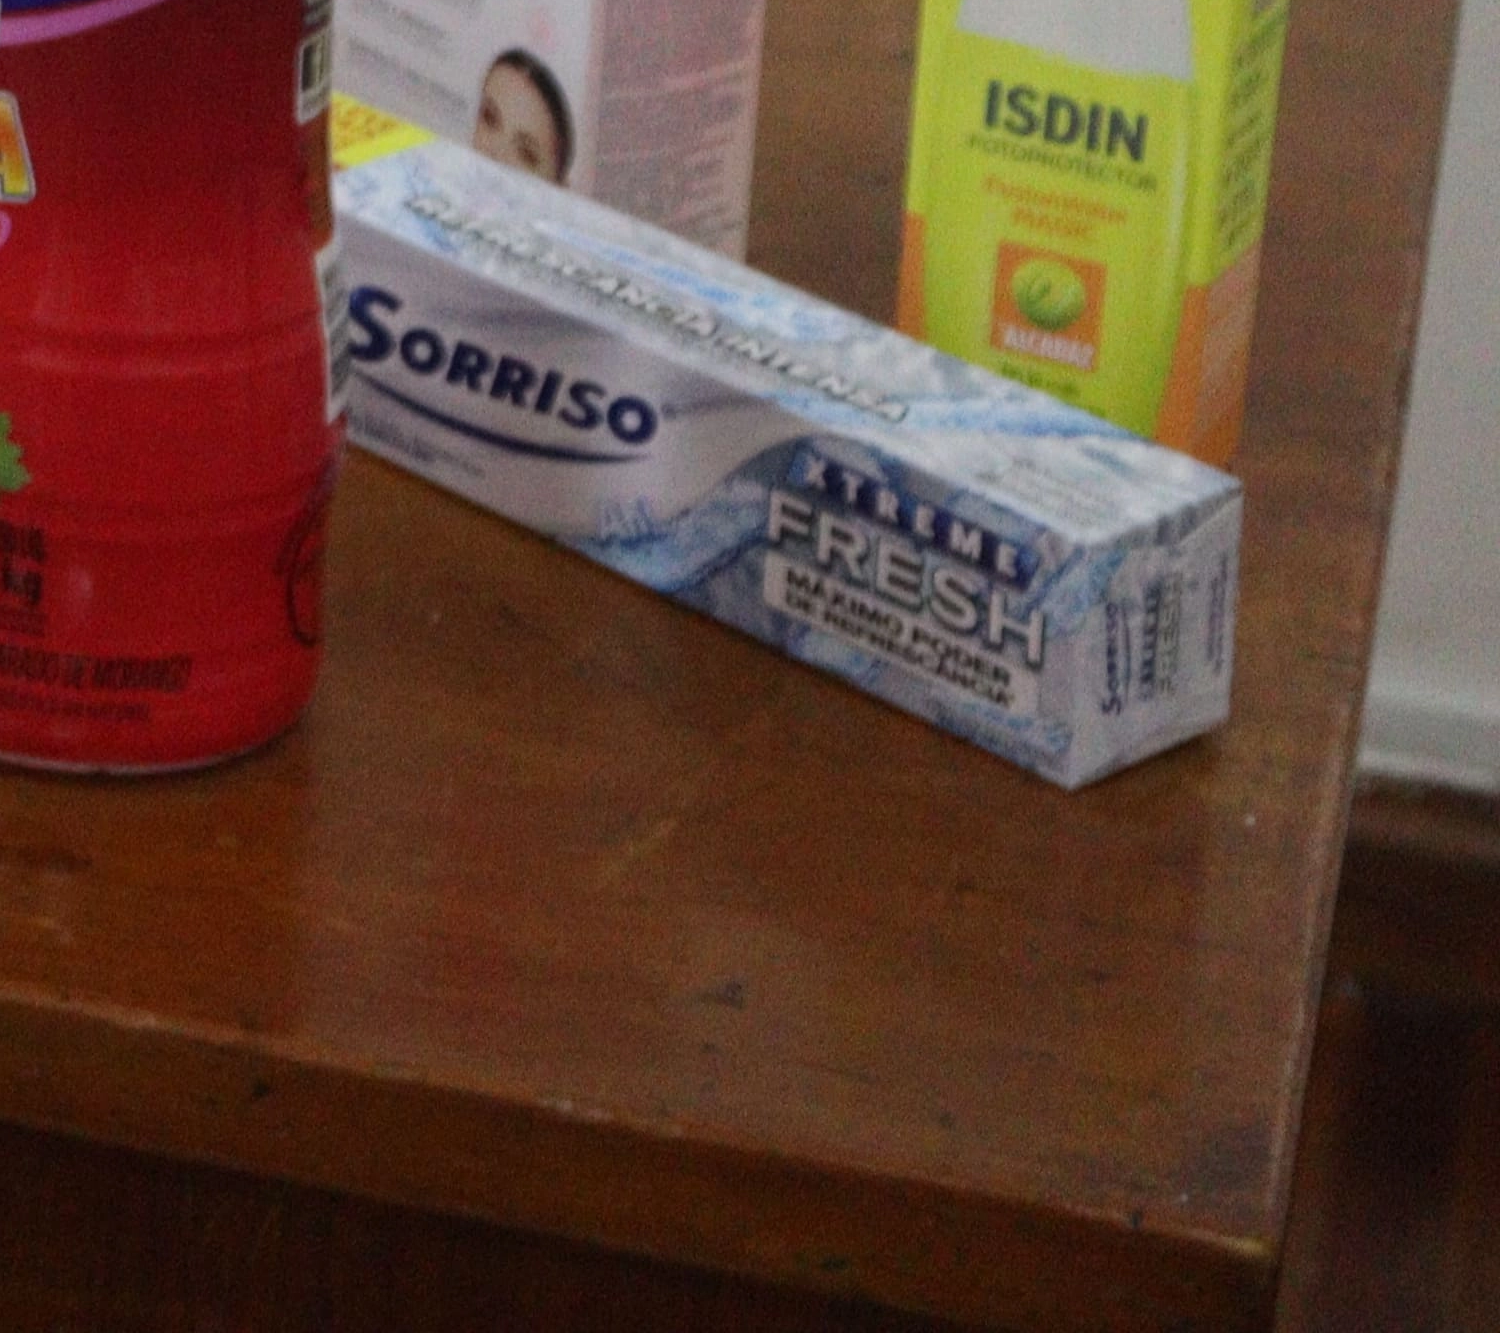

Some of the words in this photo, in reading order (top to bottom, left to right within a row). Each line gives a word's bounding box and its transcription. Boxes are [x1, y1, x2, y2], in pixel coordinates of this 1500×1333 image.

[983, 79, 1149, 163] ISDIN
[348, 284, 660, 447] SORRISO
[767, 489, 1048, 671] FRESH
[803, 452, 1020, 583] XTREME
